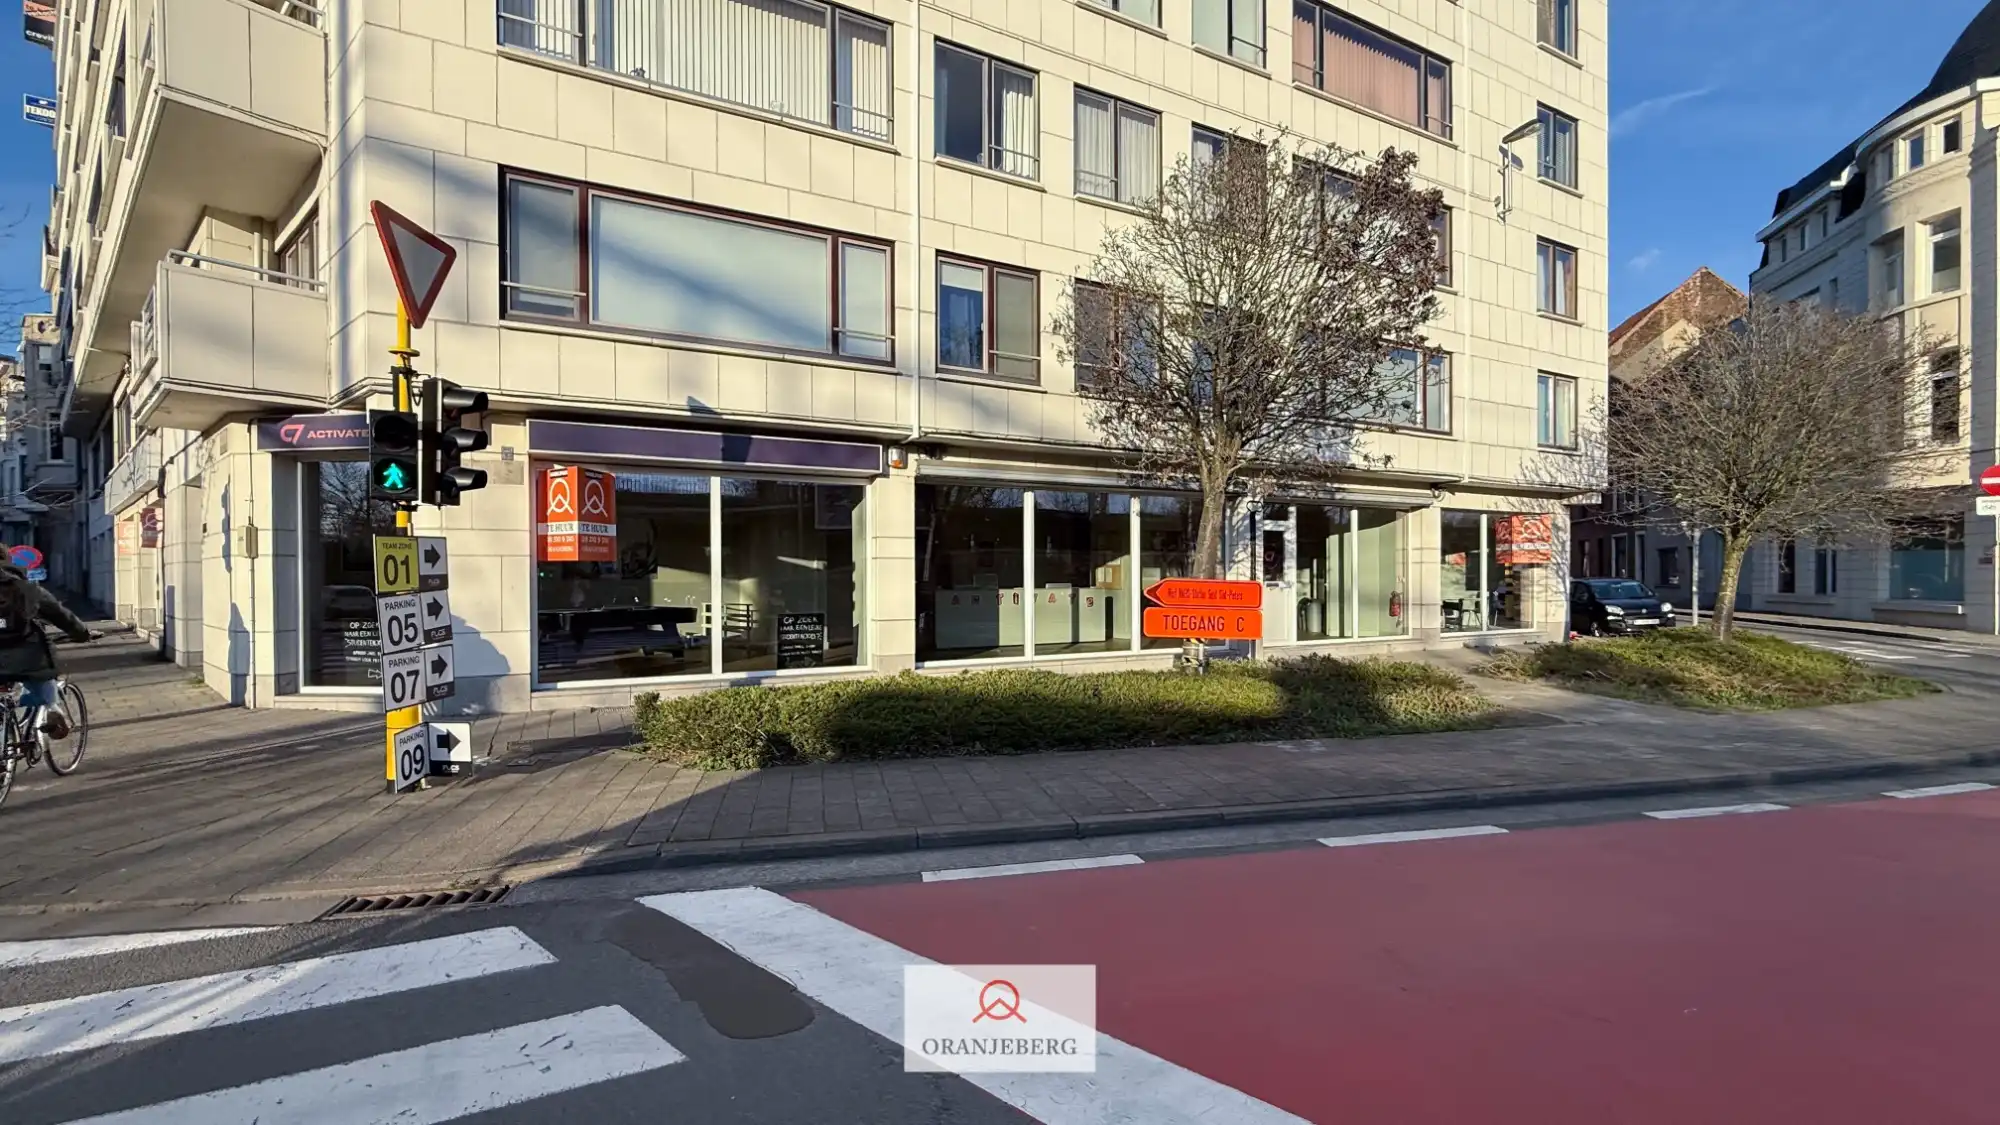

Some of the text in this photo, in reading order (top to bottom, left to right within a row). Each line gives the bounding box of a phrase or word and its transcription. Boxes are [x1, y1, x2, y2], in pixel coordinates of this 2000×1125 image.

[307, 429, 369, 439] ACTIVATE
[582, 523, 609, 533] TE HUUR
[383, 554, 410, 586] 01
[384, 599, 416, 611] PARKING
[387, 612, 419, 646] 05
[1163, 614, 1245, 632] TOEGANG C
[388, 655, 420, 668] PARKING
[390, 669, 420, 703] 07
[399, 729, 425, 747] PARKING
[401, 744, 425, 781] 09
